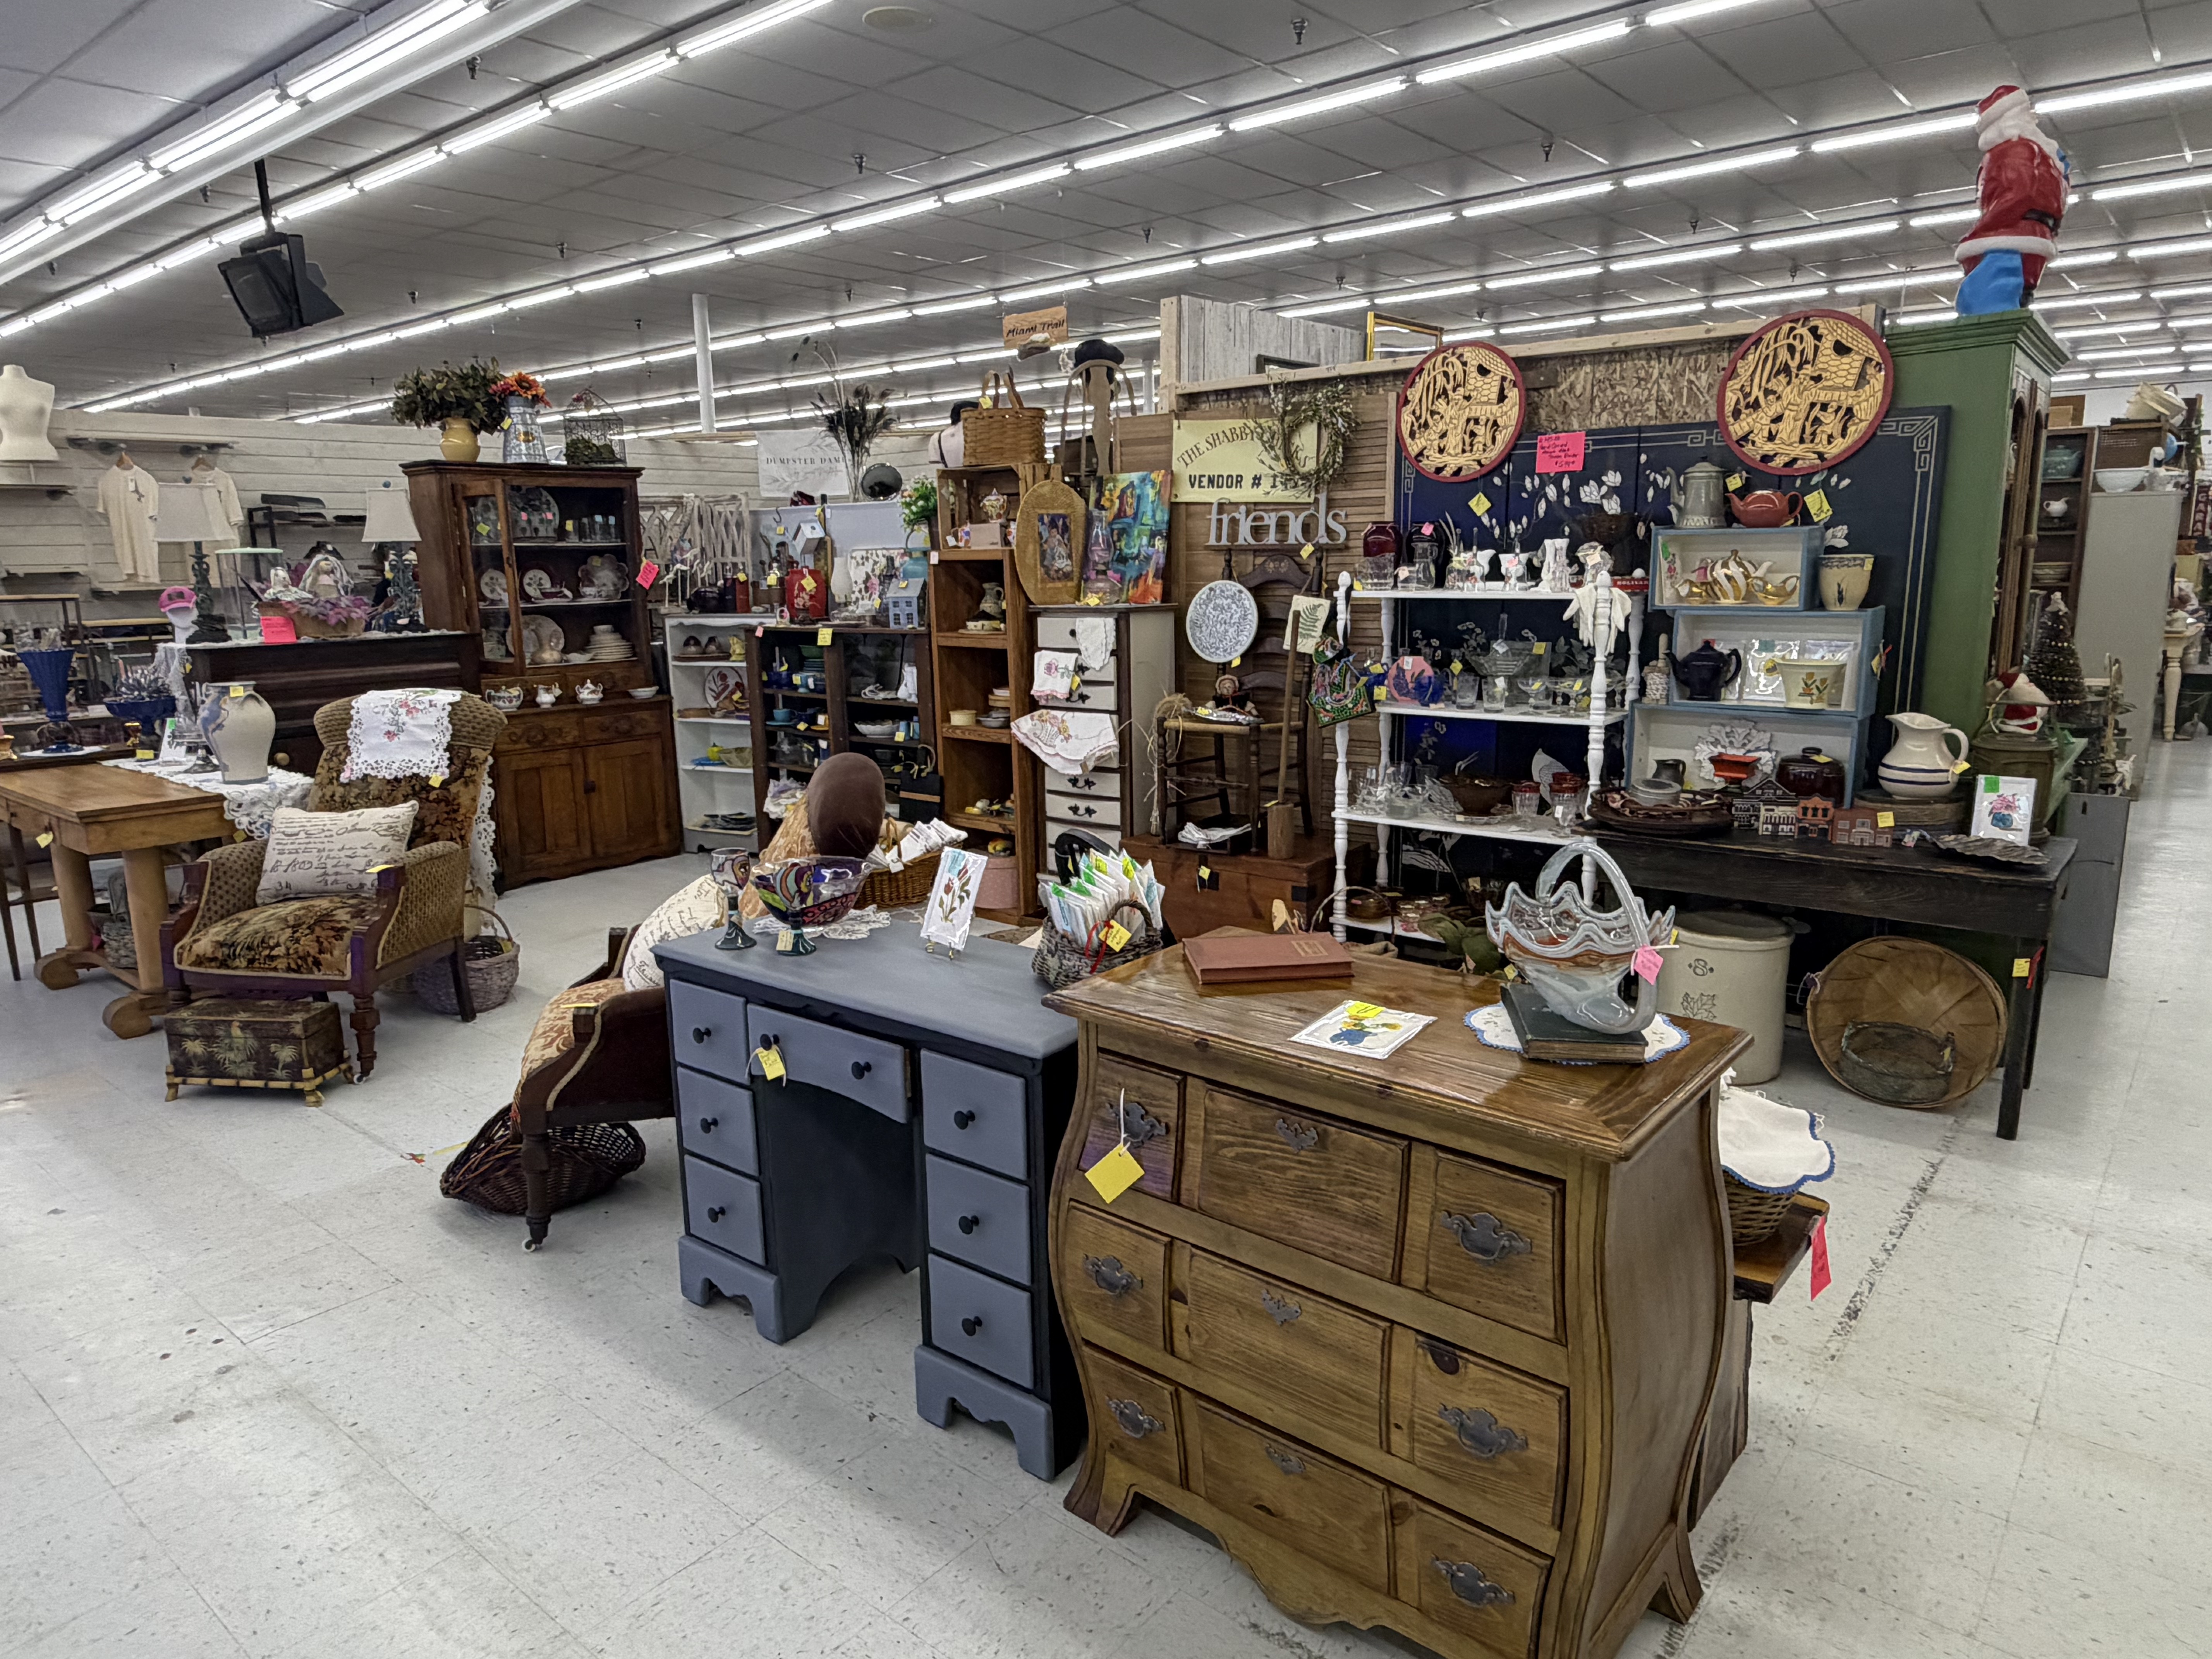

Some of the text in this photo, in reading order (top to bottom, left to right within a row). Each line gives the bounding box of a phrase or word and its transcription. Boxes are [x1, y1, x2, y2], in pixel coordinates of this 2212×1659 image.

[1006, 319, 1064, 338] Miami Trail
[1177, 442, 1205, 469] THE
[1205, 422, 1254, 451] SHABBY
[1189, 474, 1243, 489] VENDOR
[1251, 474, 1262, 489] #
[1205, 493, 1347, 545] friends
[1693, 958, 1708, 976] 8
